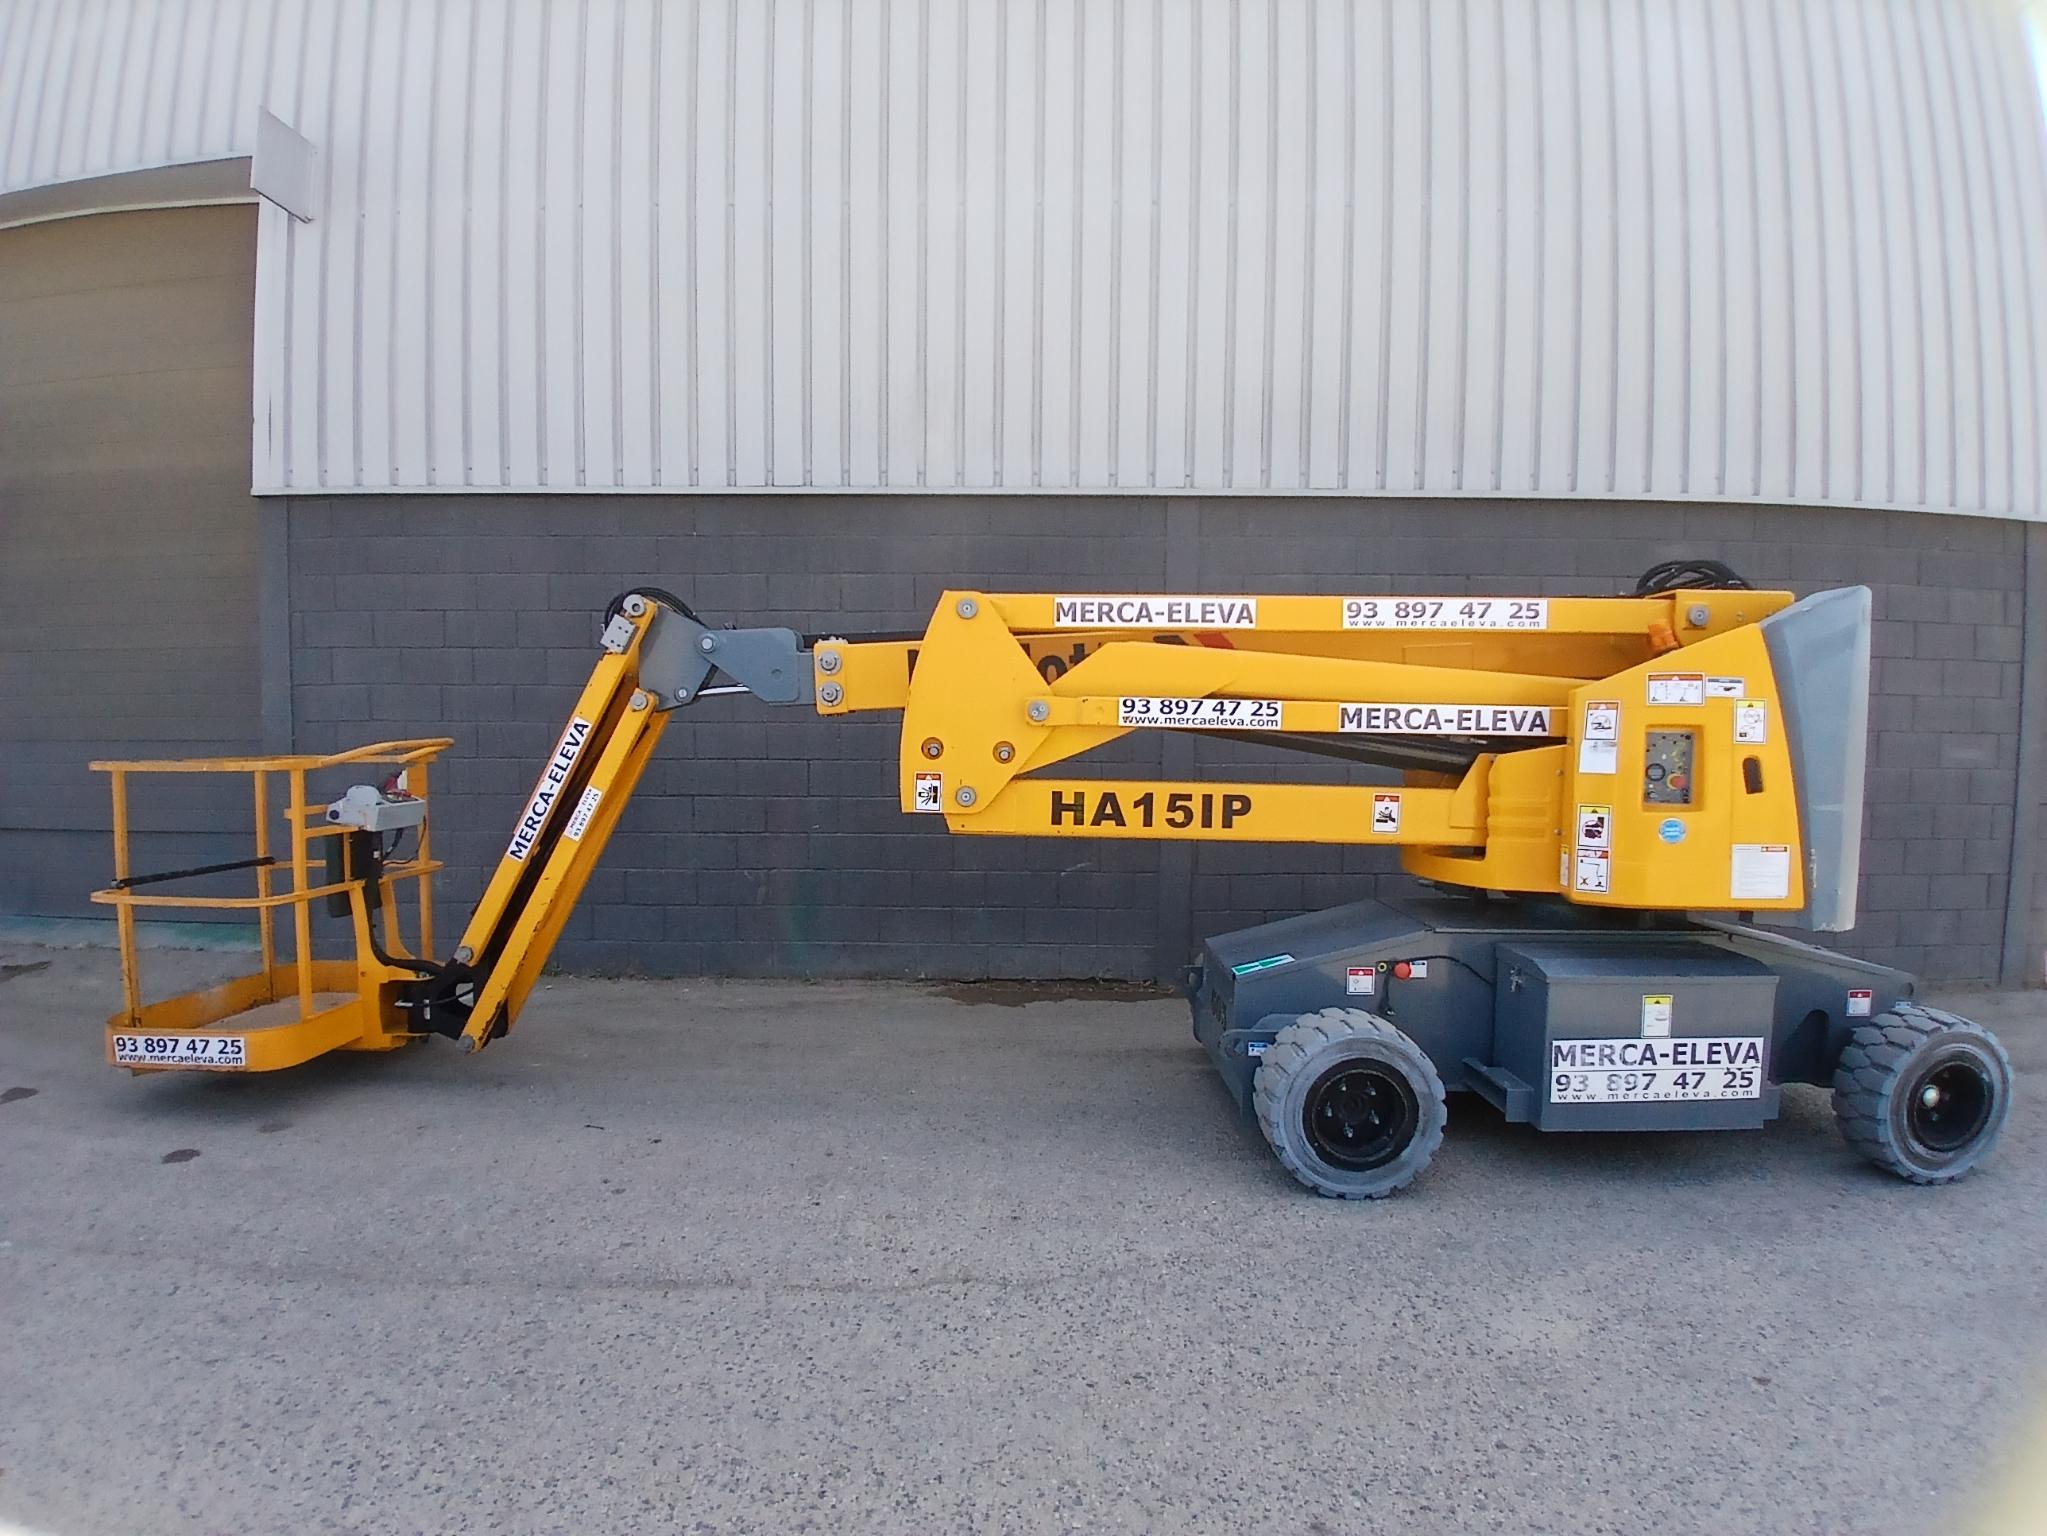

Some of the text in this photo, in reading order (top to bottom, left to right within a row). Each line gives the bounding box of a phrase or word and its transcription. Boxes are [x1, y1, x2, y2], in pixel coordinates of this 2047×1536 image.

[1056, 602, 1254, 625] MERCA-ELEVA
[1347, 602, 1540, 620] 93 897 47 25
[1122, 699, 1279, 717] 93 897 47 25
[1122, 716, 1279, 728] www.mercaeleva.com
[1340, 708, 1548, 733] MERCA-ELEVA
[509, 722, 589, 860] MERCA-ELEVA
[1051, 791, 1251, 829] HA15IP
[116, 1037, 242, 1055] 93 897 47 25
[1553, 1042, 1760, 1067] MERCA-ELEVA
[118, 1053, 243, 1065] www.mercaeleva.com
[1555, 1070, 1754, 1092] 93 897 47 25
